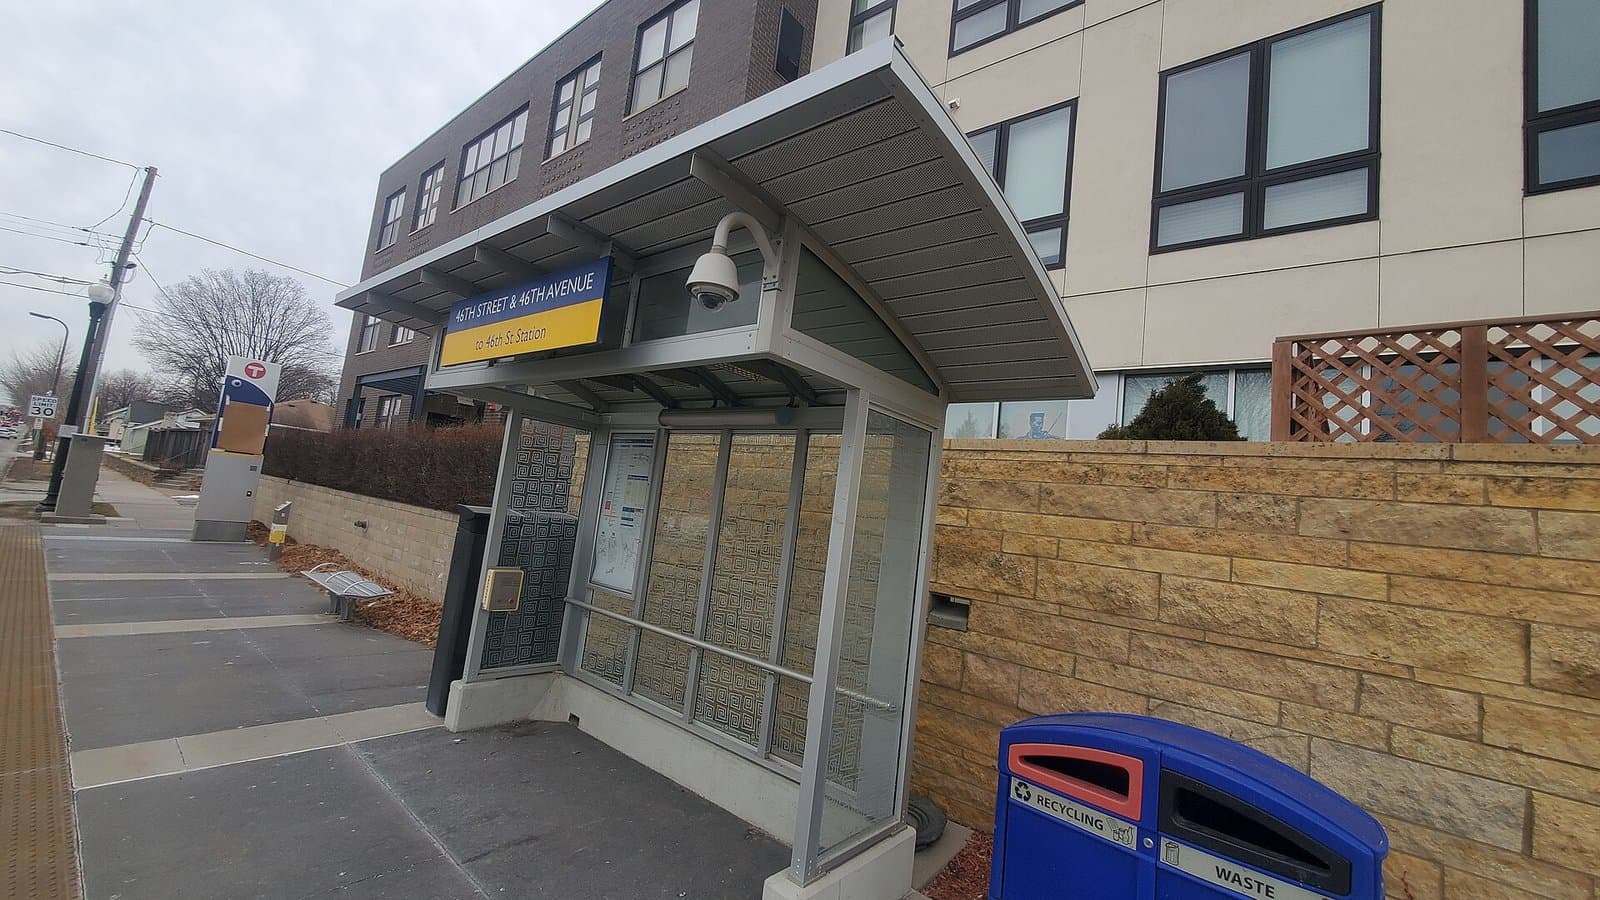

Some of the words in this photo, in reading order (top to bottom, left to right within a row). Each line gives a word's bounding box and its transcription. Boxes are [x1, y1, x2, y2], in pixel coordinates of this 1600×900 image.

[455, 306, 475, 323] 46TH
[477, 296, 509, 318] STREET
[509, 294, 517, 310] &
[519, 286, 545, 306] 46TH
[546, 272, 595, 299] AVENUE
[475, 339, 484, 351] to
[485, 333, 503, 349] 46th
[504, 330, 514, 345] St
[516, 326, 546, 343] Station
[31, 406, 54, 416] 30
[1036, 794, 1104, 831] RECYCLING
[1215, 865, 1275, 900] WASTE
